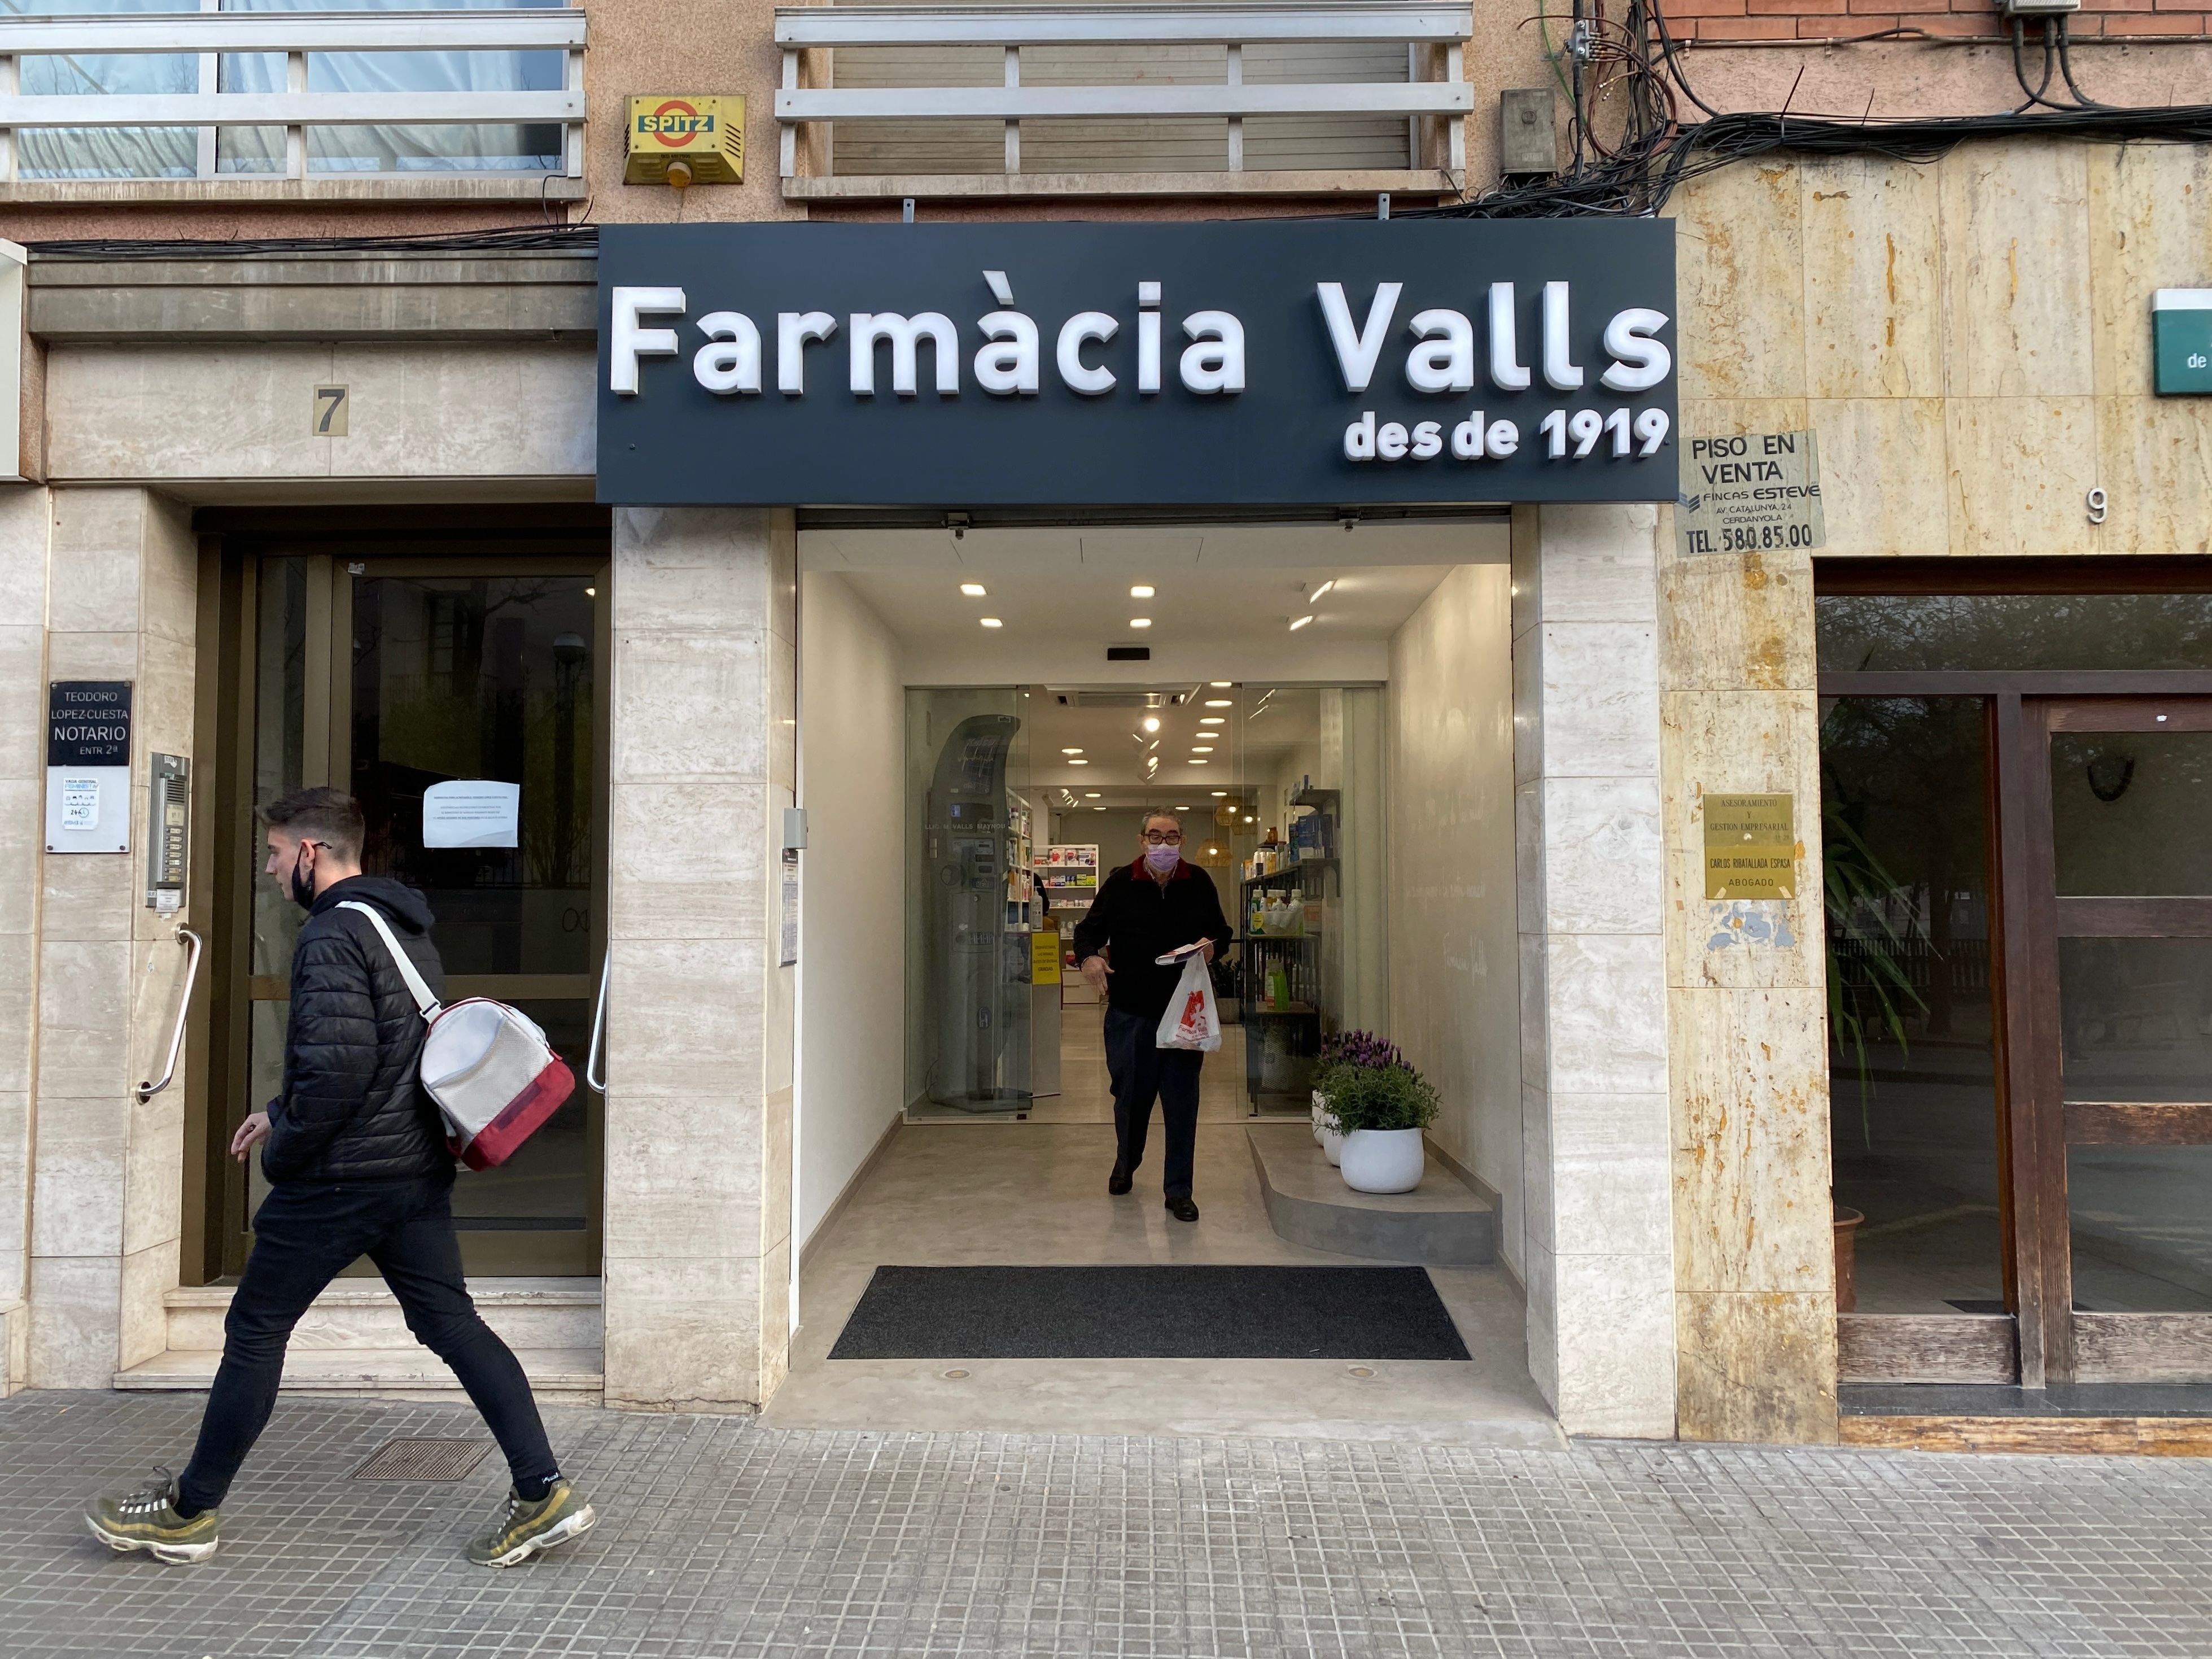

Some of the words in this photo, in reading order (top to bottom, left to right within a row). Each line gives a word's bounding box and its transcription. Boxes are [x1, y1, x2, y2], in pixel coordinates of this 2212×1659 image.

[644, 116, 709, 132] SPITZ
[610, 270, 1246, 396] Farmàcia
[1317, 281, 1672, 394] Valls
[2187, 352, 2207, 368] de
[318, 388, 346, 432] 7
[1540, 408, 1670, 460] 1919
[1692, 436, 1747, 459] PISO
[1763, 434, 1795, 455] EN
[1701, 460, 1783, 484] VENTA
[1703, 491, 1749, 501] FINCAS
[1753, 484, 1820, 500] ESTEVE
[2088, 487, 2108, 523] 9
[1723, 514, 1783, 524] CERDANYOLA
[1686, 530, 1717, 553] TEL.
[1723, 523, 1812, 551] 580.85.00
[64, 692, 118, 702] TEODORO
[54, 726, 126, 741] NOTARIO
[80, 746, 103, 755] ENTR
[1710, 823, 1738, 831] GESTION
[1741, 823, 1789, 831] EMPRESARIAL
[1710, 858, 1730, 868] CARLOS
[1771, 858, 1791, 868] ESPASA
